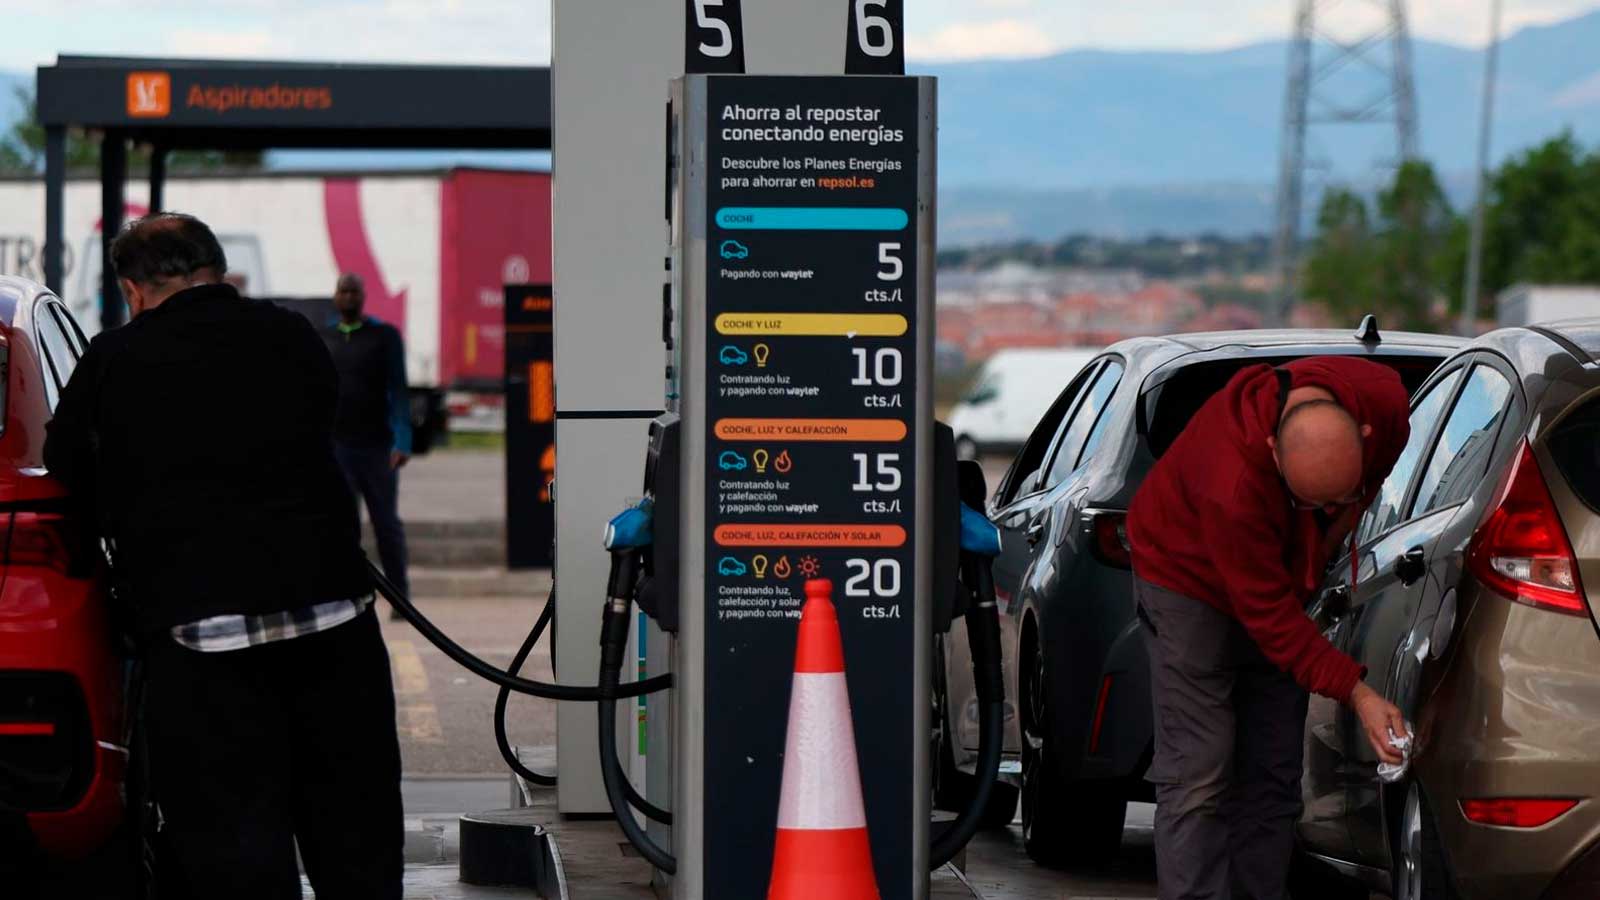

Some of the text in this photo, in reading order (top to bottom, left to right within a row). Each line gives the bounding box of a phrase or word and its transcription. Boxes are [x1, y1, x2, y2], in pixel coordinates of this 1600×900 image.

[694, 0, 733, 57] 5
[855, 0, 894, 57] 6
[186, 83, 332, 113] Aspiradores
[722, 105, 881, 124] Ahorra al repostar
[722, 125, 904, 145] conectando energías
[722, 157, 902, 172] Descubre los Planes Energías
[721, 176, 875, 190] para ahorrar en repsol.es
[723, 214, 754, 223] COCHE
[877, 242, 904, 281] 5
[720, 269, 760, 280] Pagando
[762, 270, 780, 279] con
[865, 289, 903, 302] cts./l
[722, 320, 783, 329] COCHE Y LUZ
[851, 348, 902, 386] 10
[720, 373, 791, 384] Contratando luz
[720, 387, 726, 397] y
[727, 385, 767, 397] pagando
[768, 387, 785, 395] con
[864, 394, 902, 408] cts./l
[722, 424, 848, 435] COCHE, LUZ Y CALEFACCIÓN
[852, 453, 902, 492] 15
[719, 480, 790, 490] Contratando luz
[719, 491, 778, 502] y calefacción
[719, 504, 725, 513] y
[727, 503, 766, 514] pagando
[767, 504, 784, 512] con
[863, 500, 901, 513] cts./l
[721, 530, 881, 541] COCHE, LUZ, CALEFACCIÓN Y SOLAR
[845, 559, 902, 597] 20
[719, 586, 791, 596] Contratando luz,
[719, 597, 801, 608] calefacción y solar
[719, 608, 803, 619] y pagando con way
[863, 605, 901, 618] cts./l
